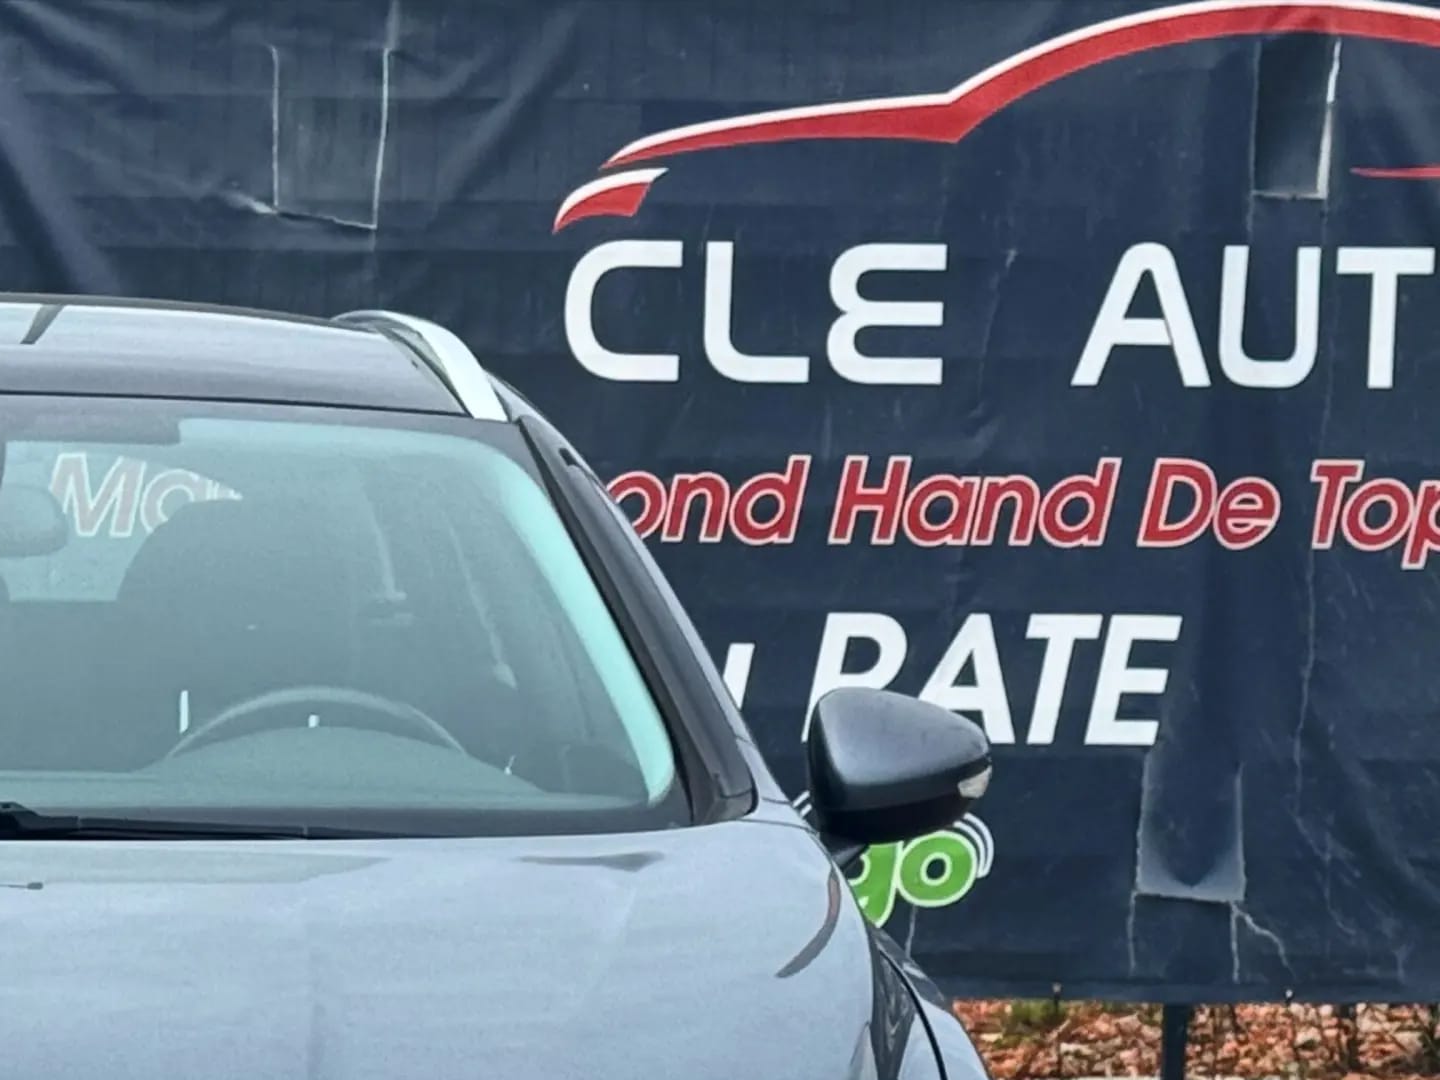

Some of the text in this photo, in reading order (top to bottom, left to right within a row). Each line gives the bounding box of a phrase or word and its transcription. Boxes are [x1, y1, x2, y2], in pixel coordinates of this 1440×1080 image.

[564, 240, 1436, 388] CLE AUT
[827, 455, 1123, 547] Hand
[1136, 458, 1281, 551] De
